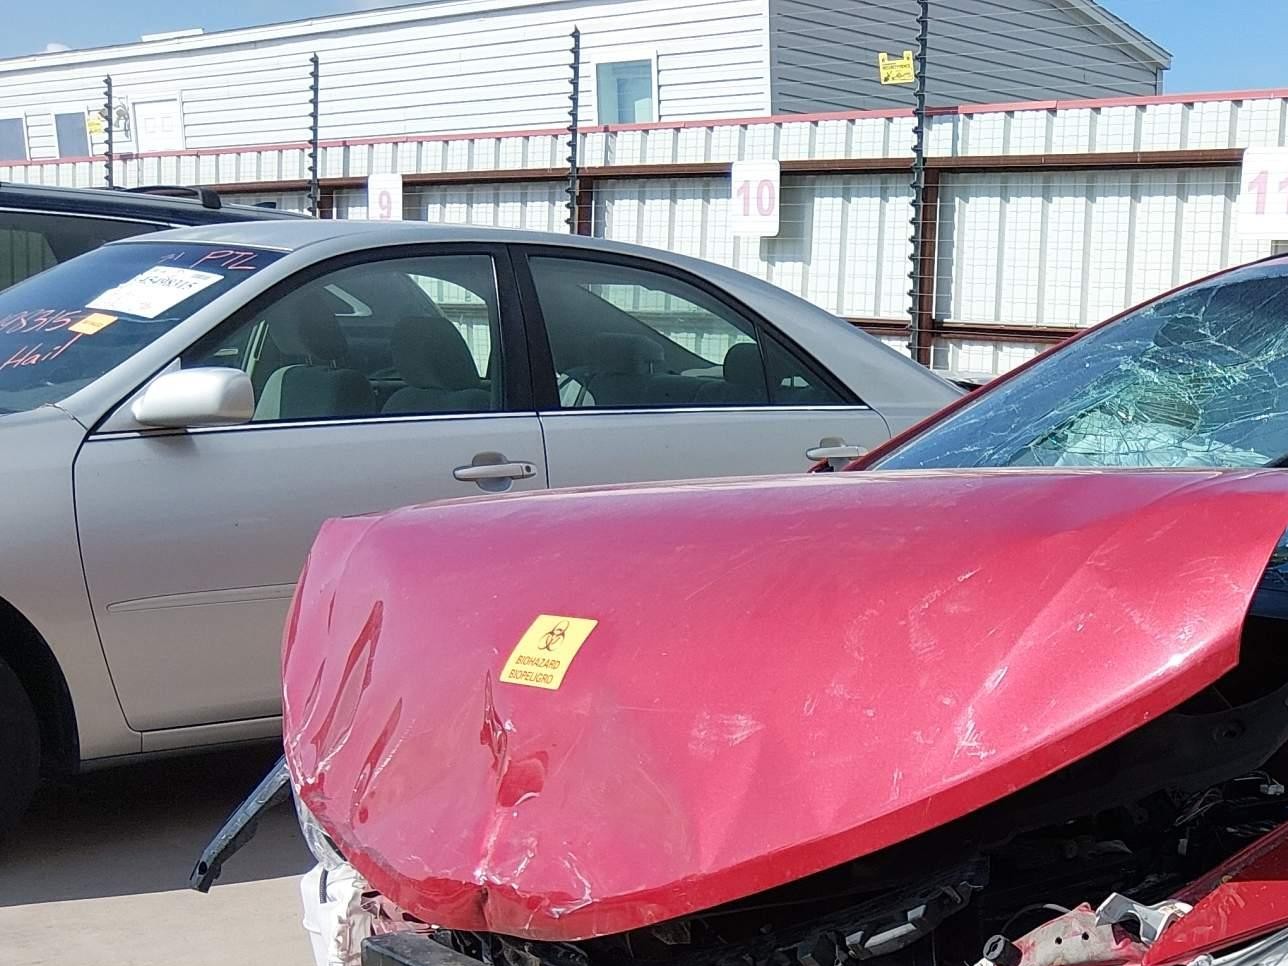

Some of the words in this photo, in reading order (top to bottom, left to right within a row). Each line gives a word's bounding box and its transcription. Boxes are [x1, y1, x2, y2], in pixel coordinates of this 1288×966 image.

[378, 190, 392, 219] 9
[737, 179, 776, 217] 10
[0, 332, 83, 371] Hail
[508, 668, 554, 685] BIOPELIGRO
[514, 655, 561, 670] BIOHAZARD
